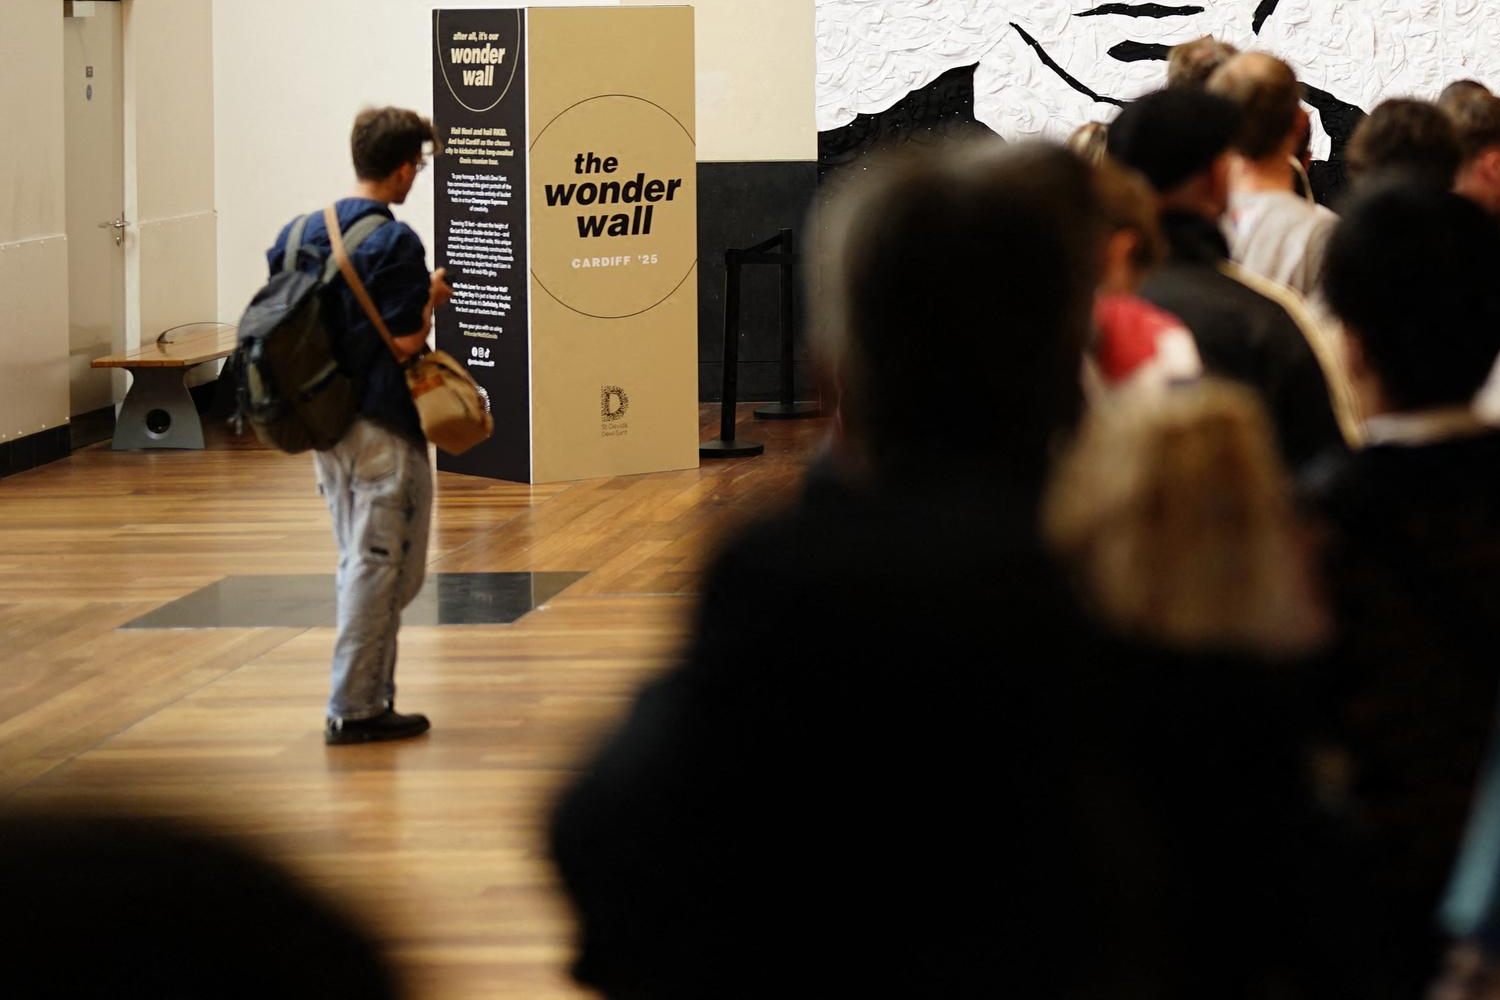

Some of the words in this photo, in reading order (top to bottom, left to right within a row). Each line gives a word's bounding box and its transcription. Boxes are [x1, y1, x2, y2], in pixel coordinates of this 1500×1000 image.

[453, 32, 468, 41] after
[468, 32, 477, 42] all,
[478, 32, 488, 41] it's
[451, 43, 506, 64] wonder
[462, 65, 494, 86] wall
[574, 152, 618, 174] the
[545, 173, 682, 206] wonder
[577, 205, 654, 238] wall
[572, 255, 632, 268] CARDIFF
[638, 254, 658, 265] '25
